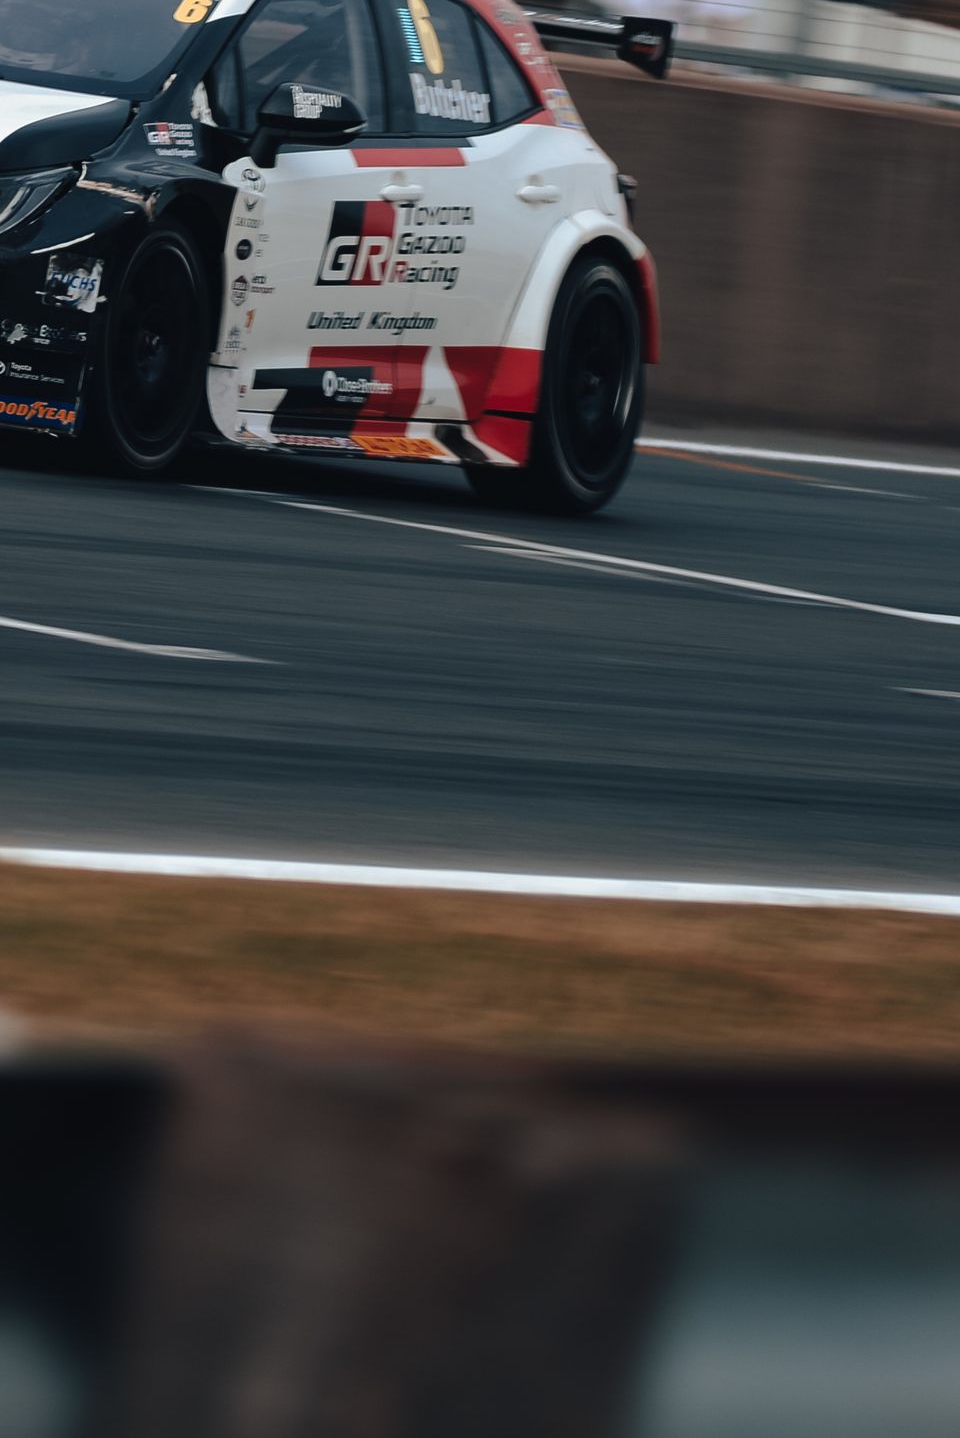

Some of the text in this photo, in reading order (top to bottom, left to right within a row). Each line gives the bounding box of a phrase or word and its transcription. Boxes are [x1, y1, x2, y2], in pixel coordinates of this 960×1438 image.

[397, 203, 475, 227] TOYOTA
[397, 232, 467, 255] GAZOO
[319, 235, 394, 282] GR
[388, 260, 460, 290] Racing
[306, 311, 438, 336] United Kingdom
